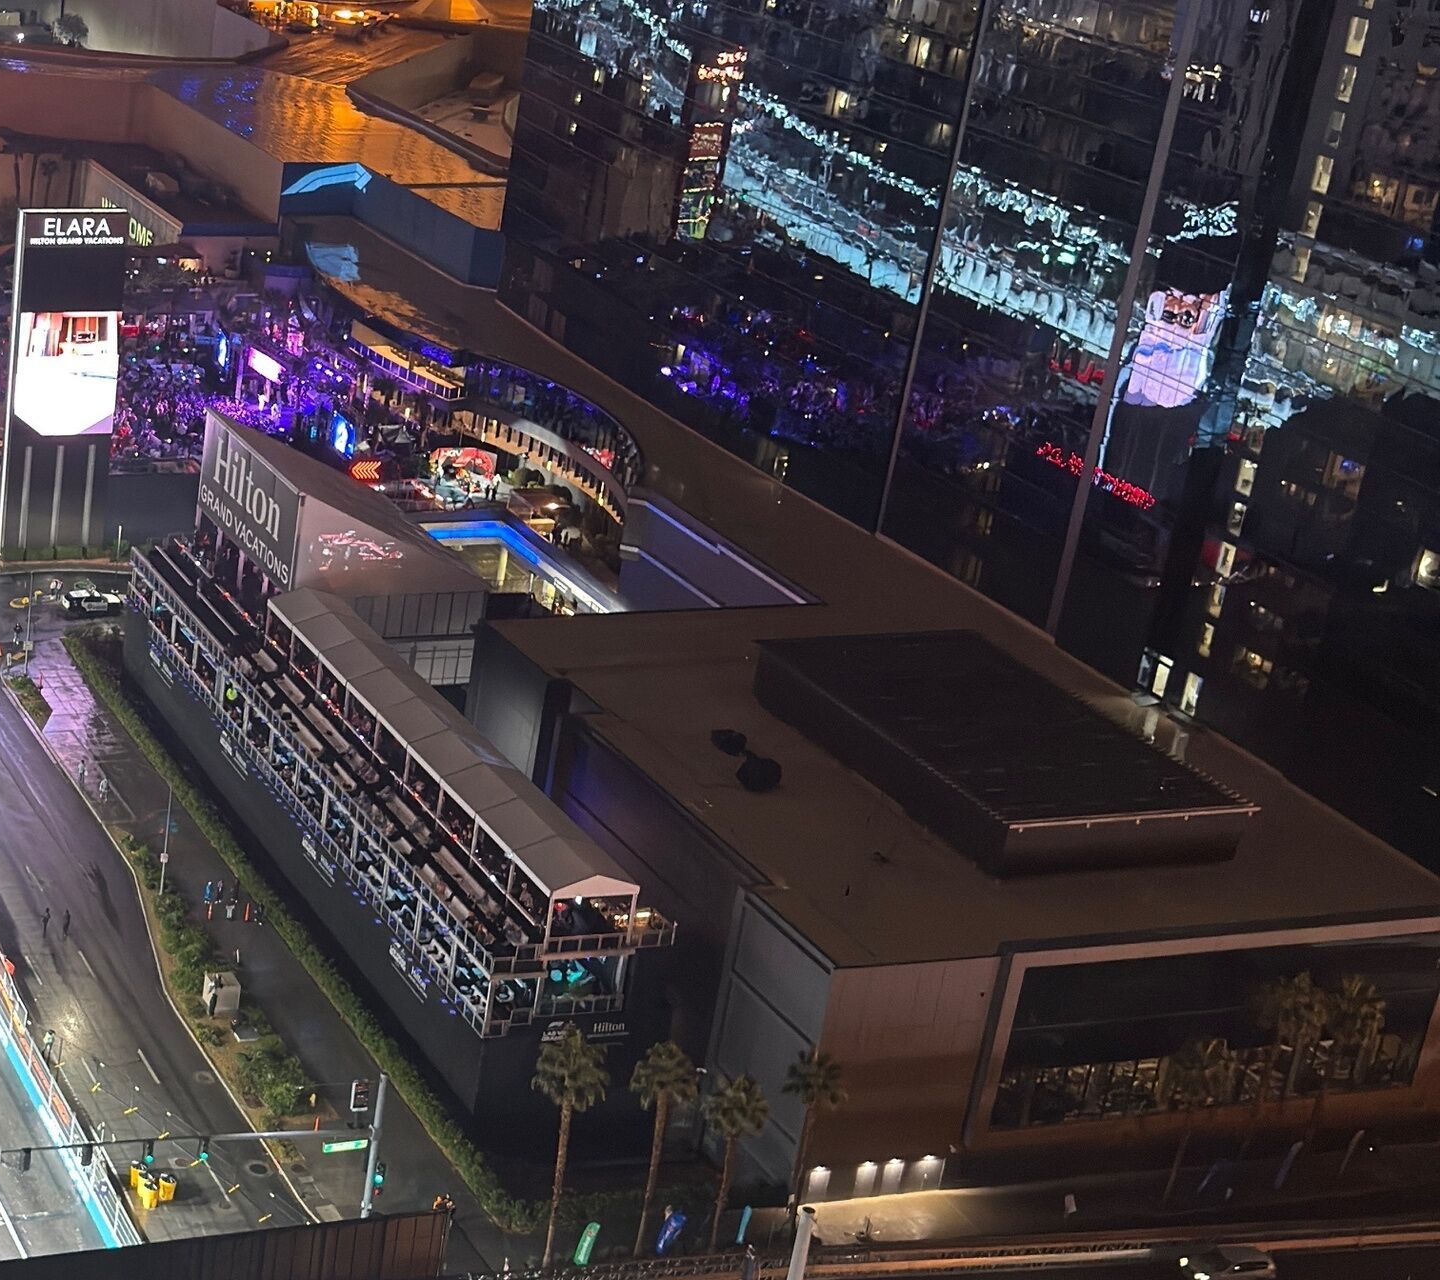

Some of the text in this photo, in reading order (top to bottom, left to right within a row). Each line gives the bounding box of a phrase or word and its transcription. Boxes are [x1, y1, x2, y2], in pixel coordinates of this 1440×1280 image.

[43, 217, 111, 236] ELARA
[30, 236, 124, 245] HILTON GRAND VACATIONS
[213, 435, 281, 542] Hilton
[200, 484, 289, 585] GRAND VACATIONS
[593, 1022, 625, 1032] Hilton
